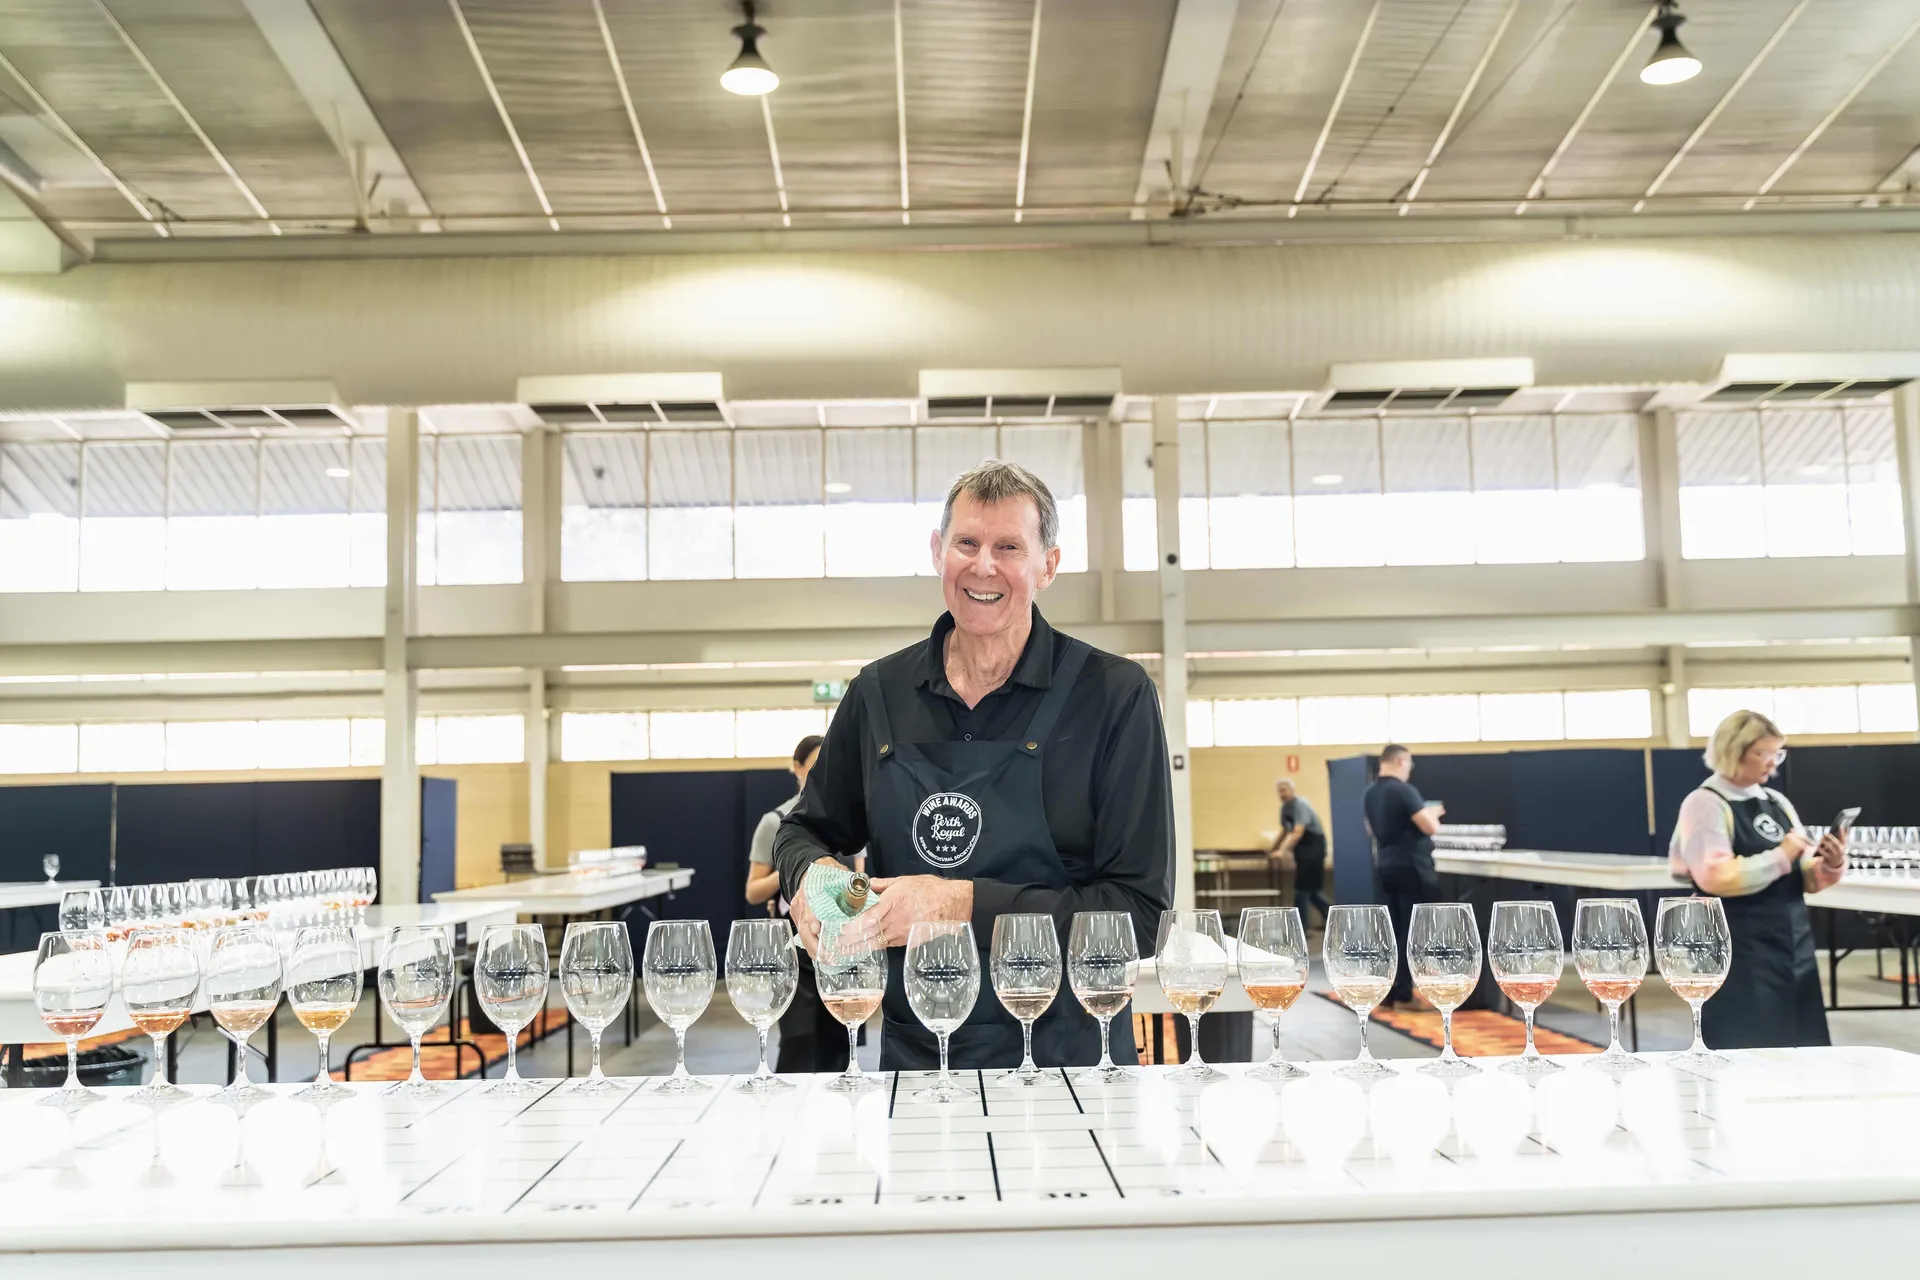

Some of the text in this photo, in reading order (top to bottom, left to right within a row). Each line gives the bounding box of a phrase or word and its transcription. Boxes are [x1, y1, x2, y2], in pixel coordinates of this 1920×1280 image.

[921, 796, 978, 820] WINE AWARDS
[932, 813, 963, 828] Perth
[930, 824, 966, 841] Royal
